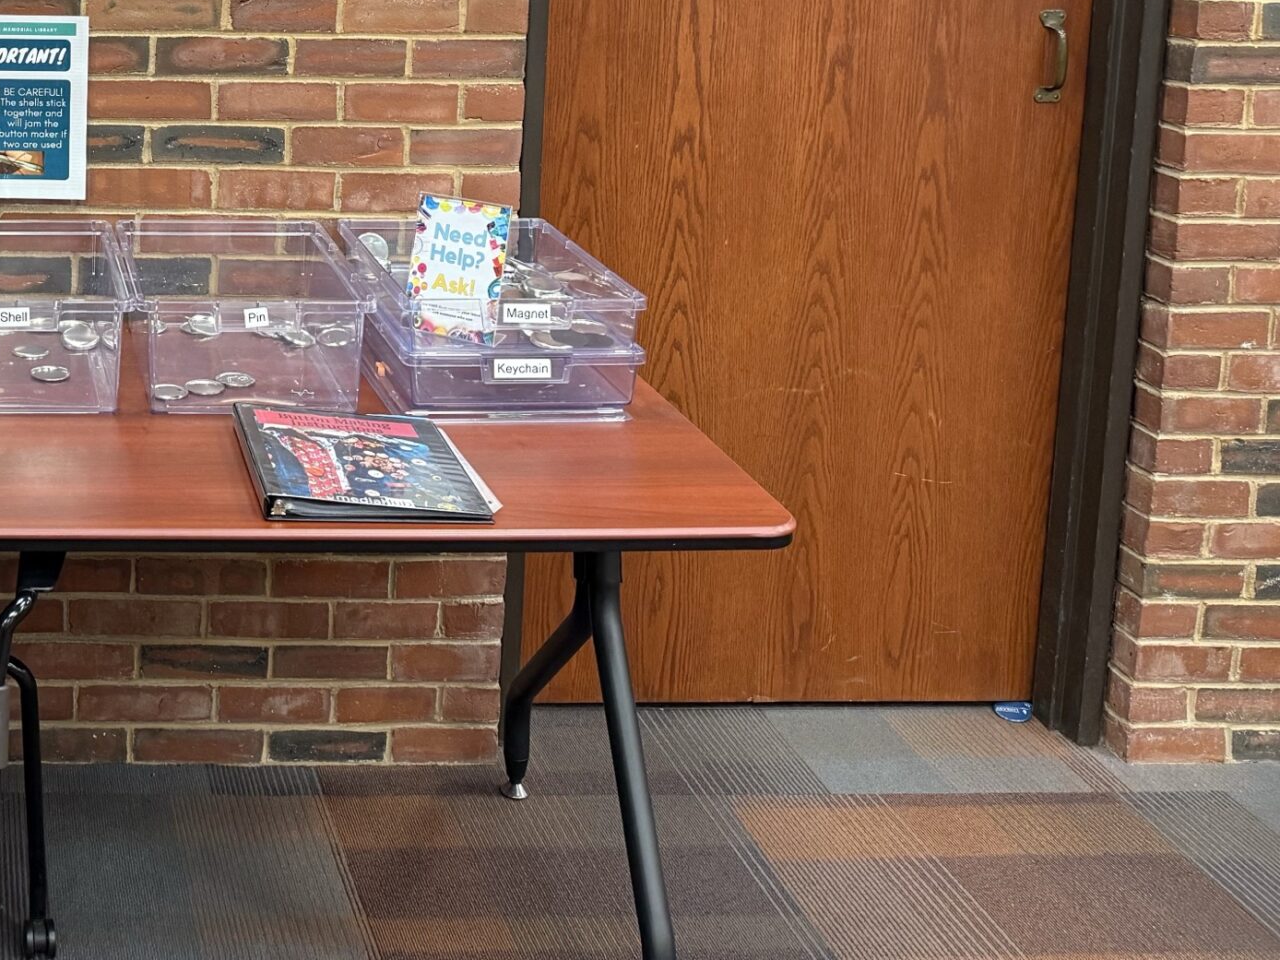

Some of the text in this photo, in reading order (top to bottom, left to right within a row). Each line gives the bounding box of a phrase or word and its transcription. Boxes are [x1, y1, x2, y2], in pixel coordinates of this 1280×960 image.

[3, 87, 63, 97] BE CAREFUL!
[0, 97, 66, 107] The shells stick
[3, 108, 63, 119] together and
[7, 119, 59, 130] will jam the
[30, 128, 59, 138] maker
[61, 129, 68, 138] if
[3, 140, 20, 148] two
[40, 140, 63, 149] used
[433, 222, 488, 248] Need
[430, 243, 485, 271] Help?
[431, 273, 476, 297] Ask!
[0, 311, 28, 323] Shell
[248, 312, 266, 323] Pin
[506, 307, 549, 320] Magnet
[497, 362, 549, 376] Keychain
[278, 412, 392, 430] Button Making
[291, 420, 384, 434] Instructions
